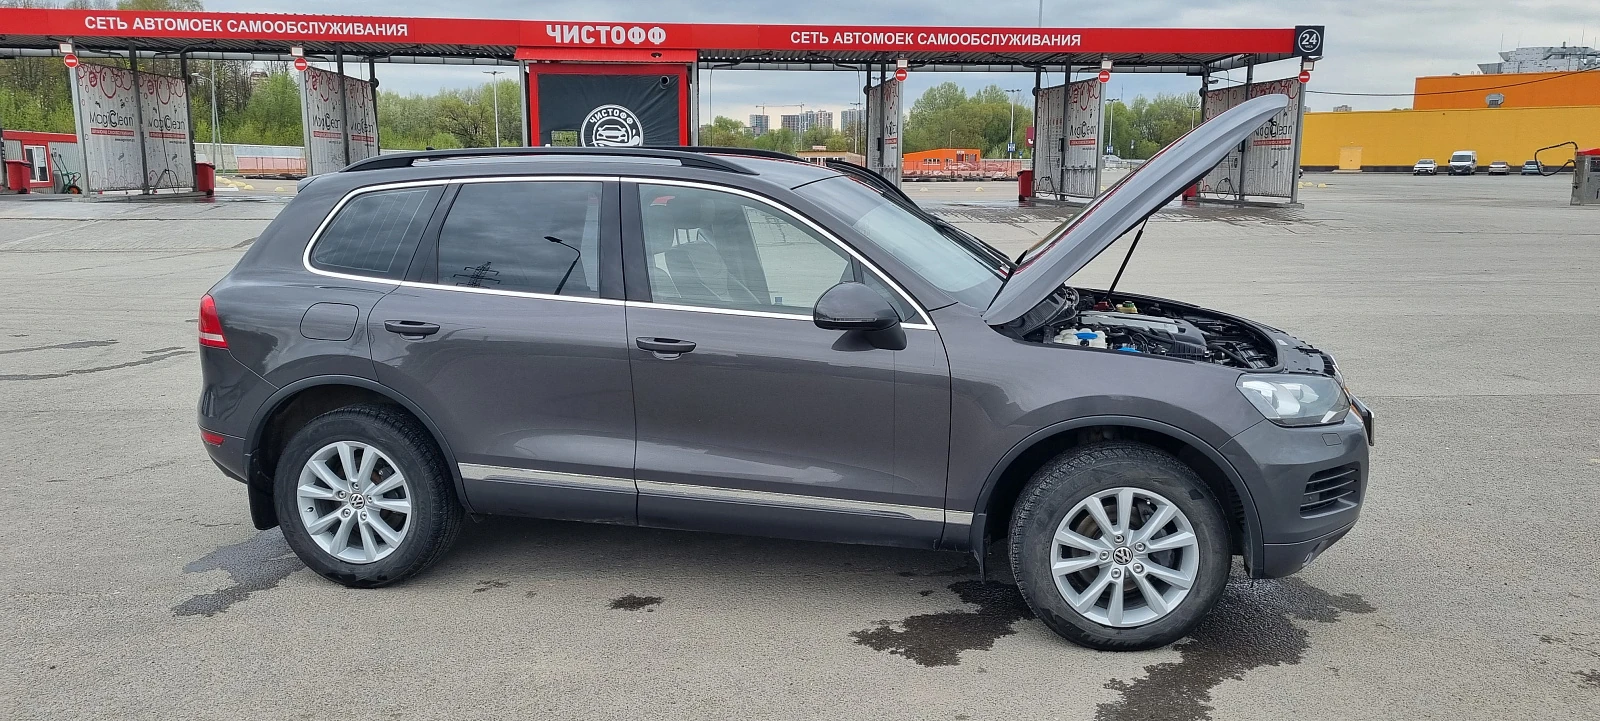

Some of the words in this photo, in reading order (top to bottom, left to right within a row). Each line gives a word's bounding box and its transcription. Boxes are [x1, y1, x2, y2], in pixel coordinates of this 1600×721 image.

[84, 16, 128, 30] СЕТЬ
[132, 17, 223, 32] АВТОМОЕК
[226, 19, 408, 36] САМООБСЛУЖИВАНИЯ
[546, 24, 667, 45] ЧИСТОФФ
[790, 31, 829, 44] СЕТЬ
[832, 32, 914, 45] АВТОМОЕК
[917, 32, 1081, 46] САМООБСЛУЖИВАНИЯ
[1301, 33, 1317, 45] 24
[90, 110, 134, 128] MagiClean
[589, 108, 634, 124] ЧИСТОФФ
